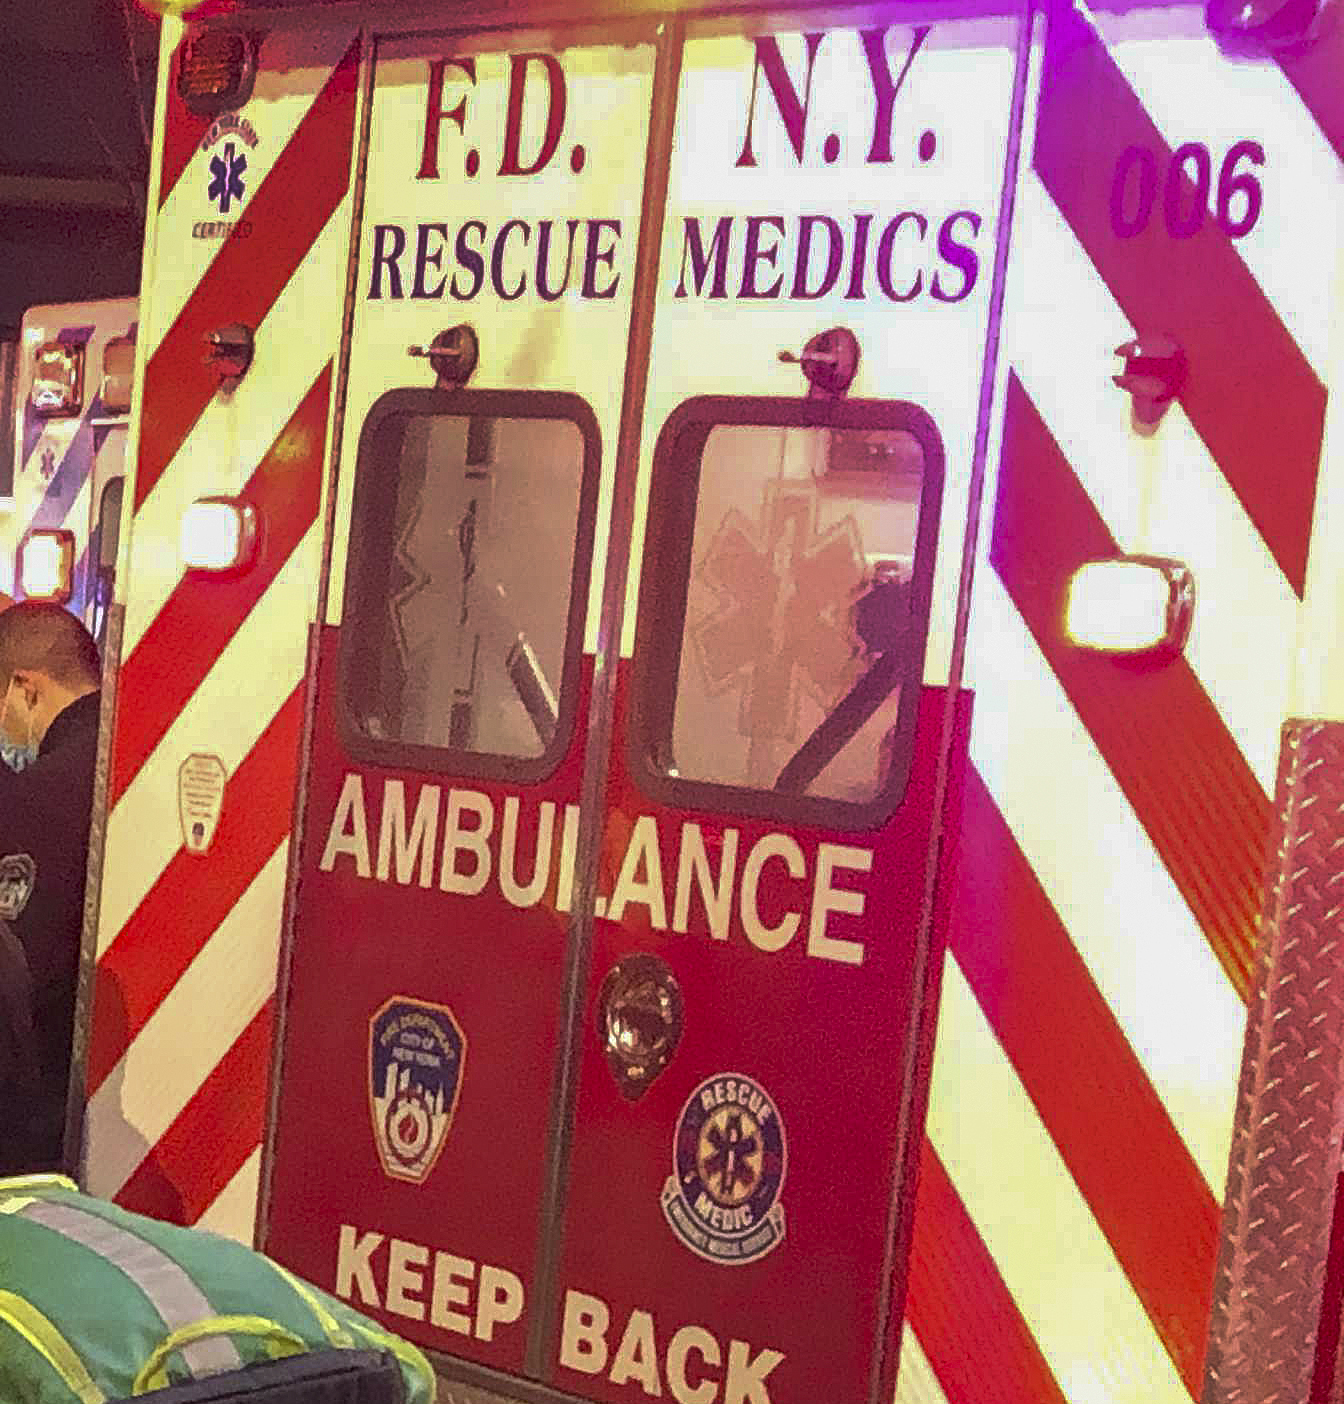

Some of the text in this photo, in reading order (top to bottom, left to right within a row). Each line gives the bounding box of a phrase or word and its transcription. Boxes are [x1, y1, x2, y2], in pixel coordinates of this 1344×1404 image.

[415, 26, 939, 181] F.D. N.Y.
[1110, 140, 1266, 239] 006
[367, 211, 982, 303] RESCUE MEDICS
[319, 773, 874, 967] AMBULANCE
[700, 1079, 773, 1126] RESCUE
[694, 1191, 754, 1231] MEDIC
[335, 1224, 525, 1342] KEEP
